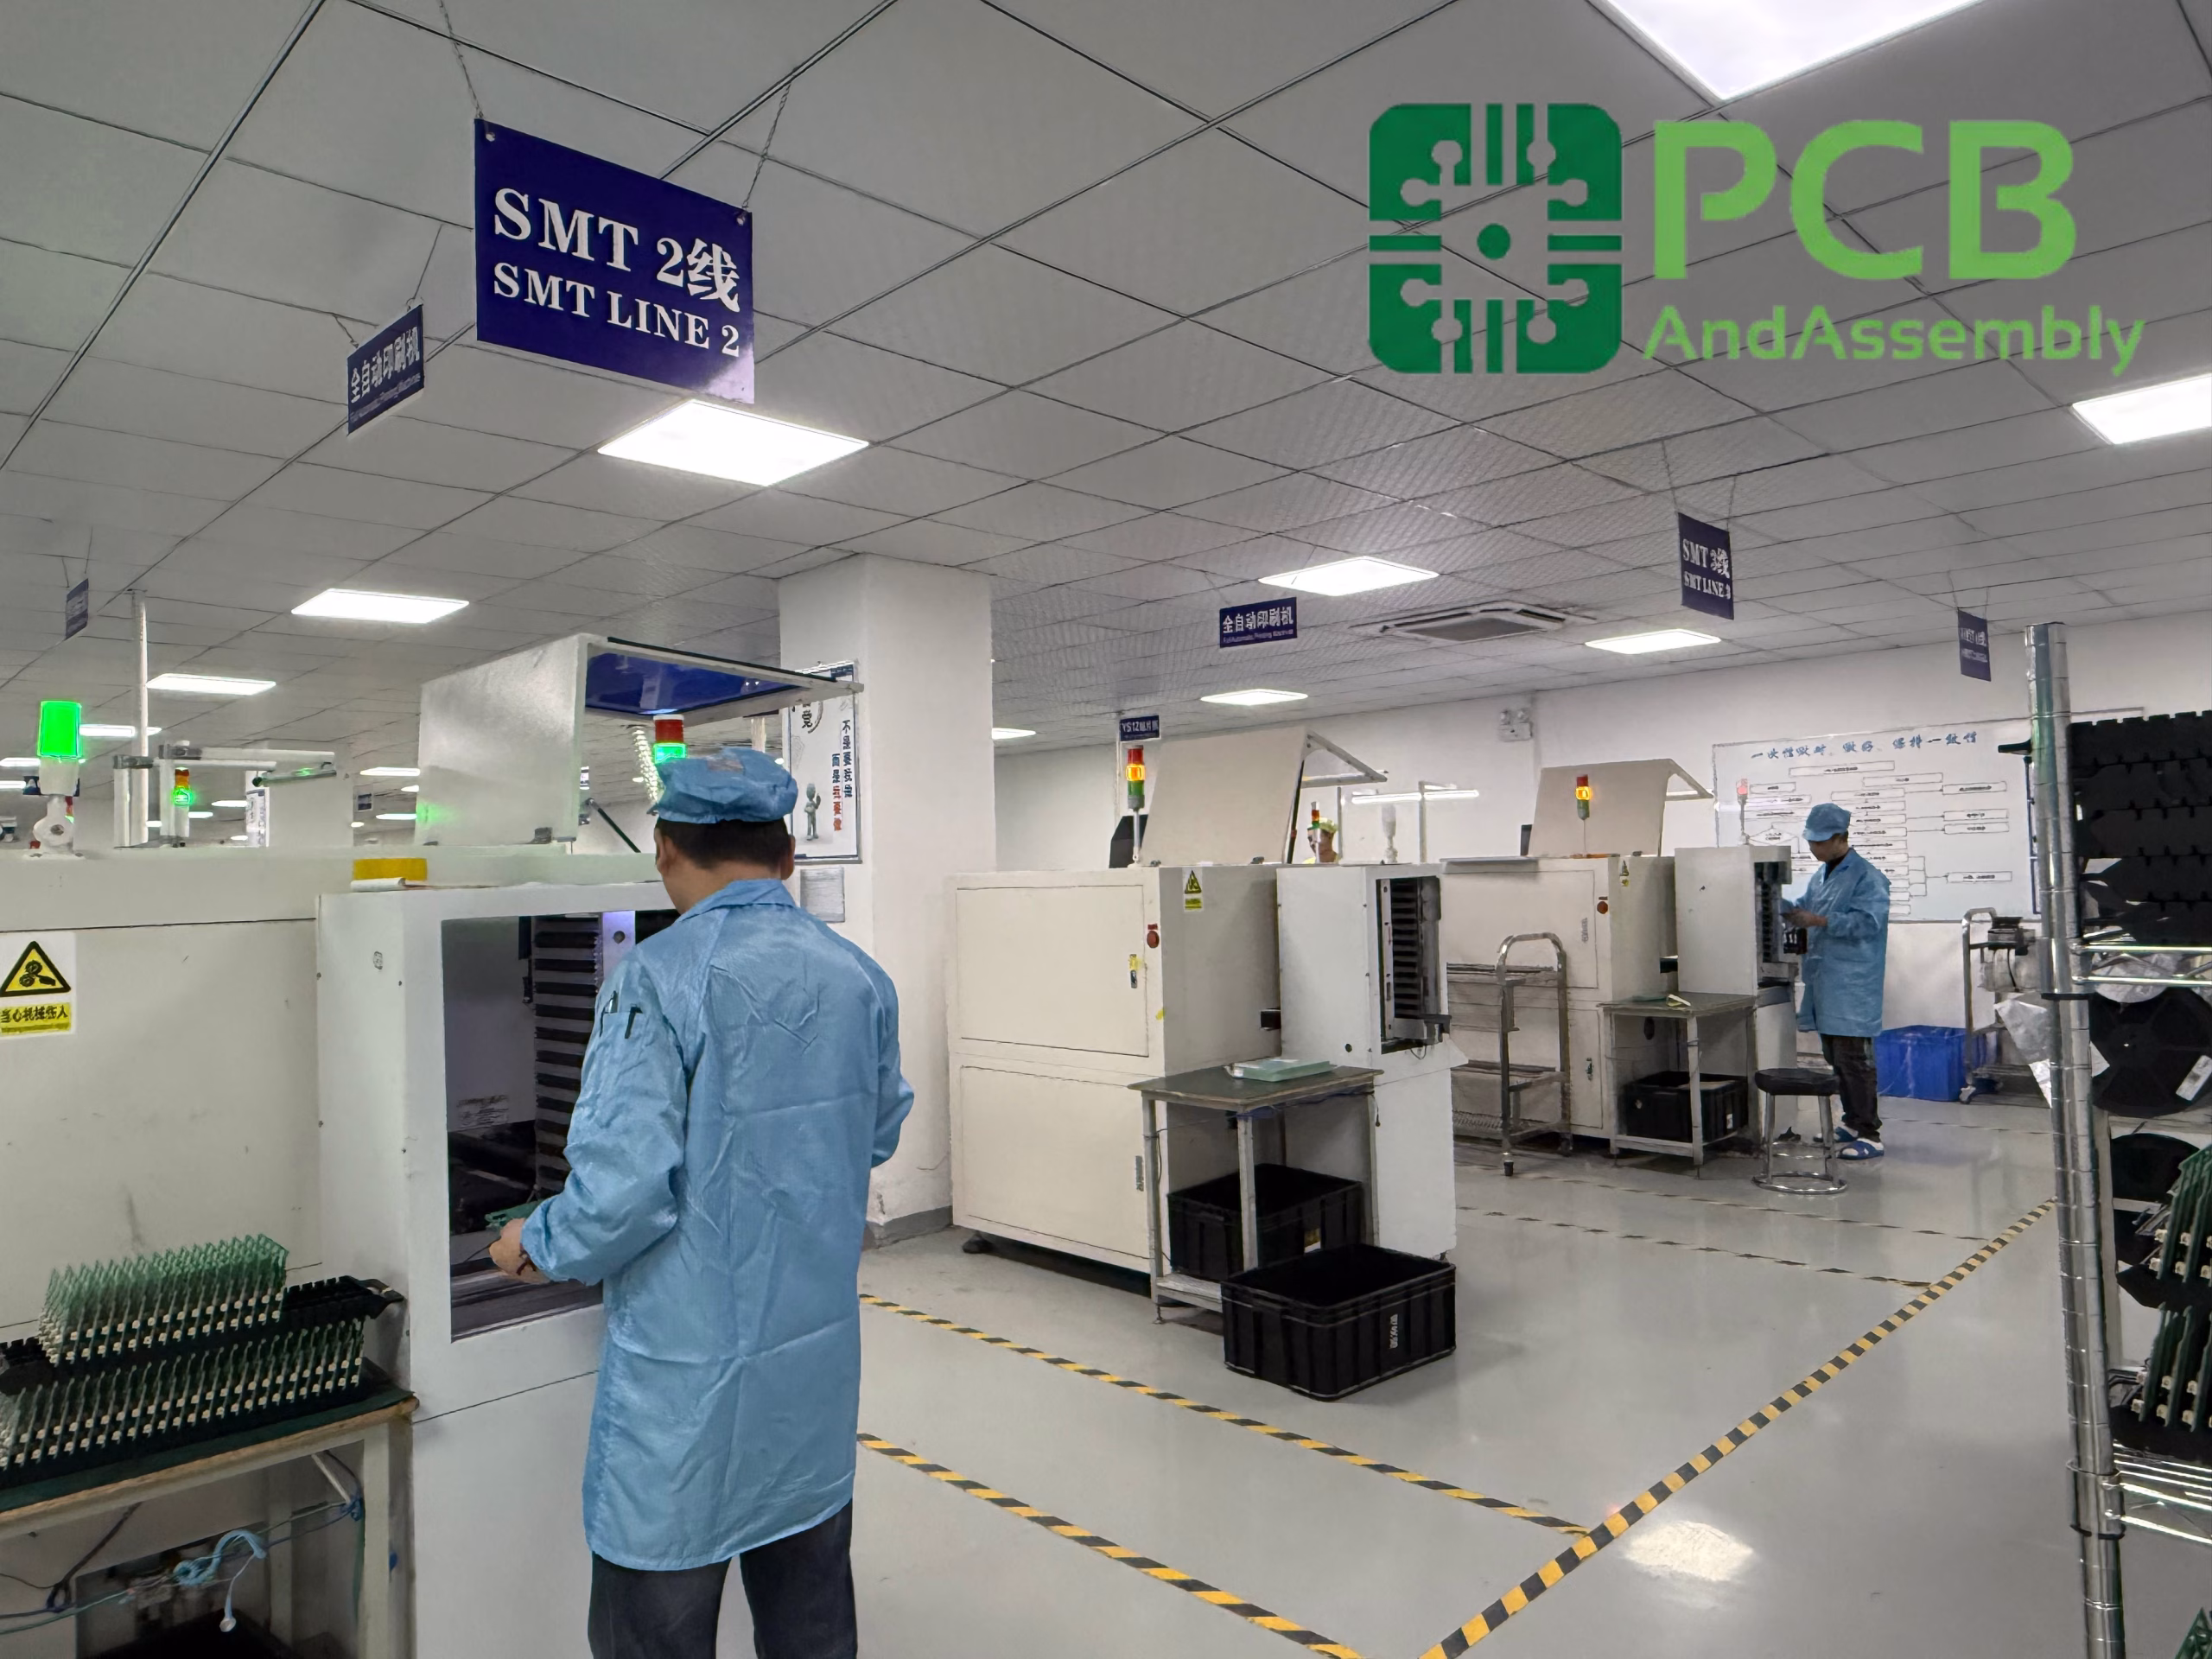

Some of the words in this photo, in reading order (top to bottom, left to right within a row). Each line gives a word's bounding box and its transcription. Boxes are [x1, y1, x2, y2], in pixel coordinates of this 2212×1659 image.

[494, 188, 639, 272] SMT
[656, 237, 741, 313] 2线
[493, 262, 595, 317] SMT
[607, 290, 710, 349] LINE
[721, 324, 741, 358] 2
[1682, 538, 1709, 569] SMT
[1683, 570, 1702, 591] SMT
[1702, 577, 1724, 598] LINE
[1223, 606, 1294, 633] 全自动印刷机
[0, 1004, 69, 1024] 当心机械伤人
